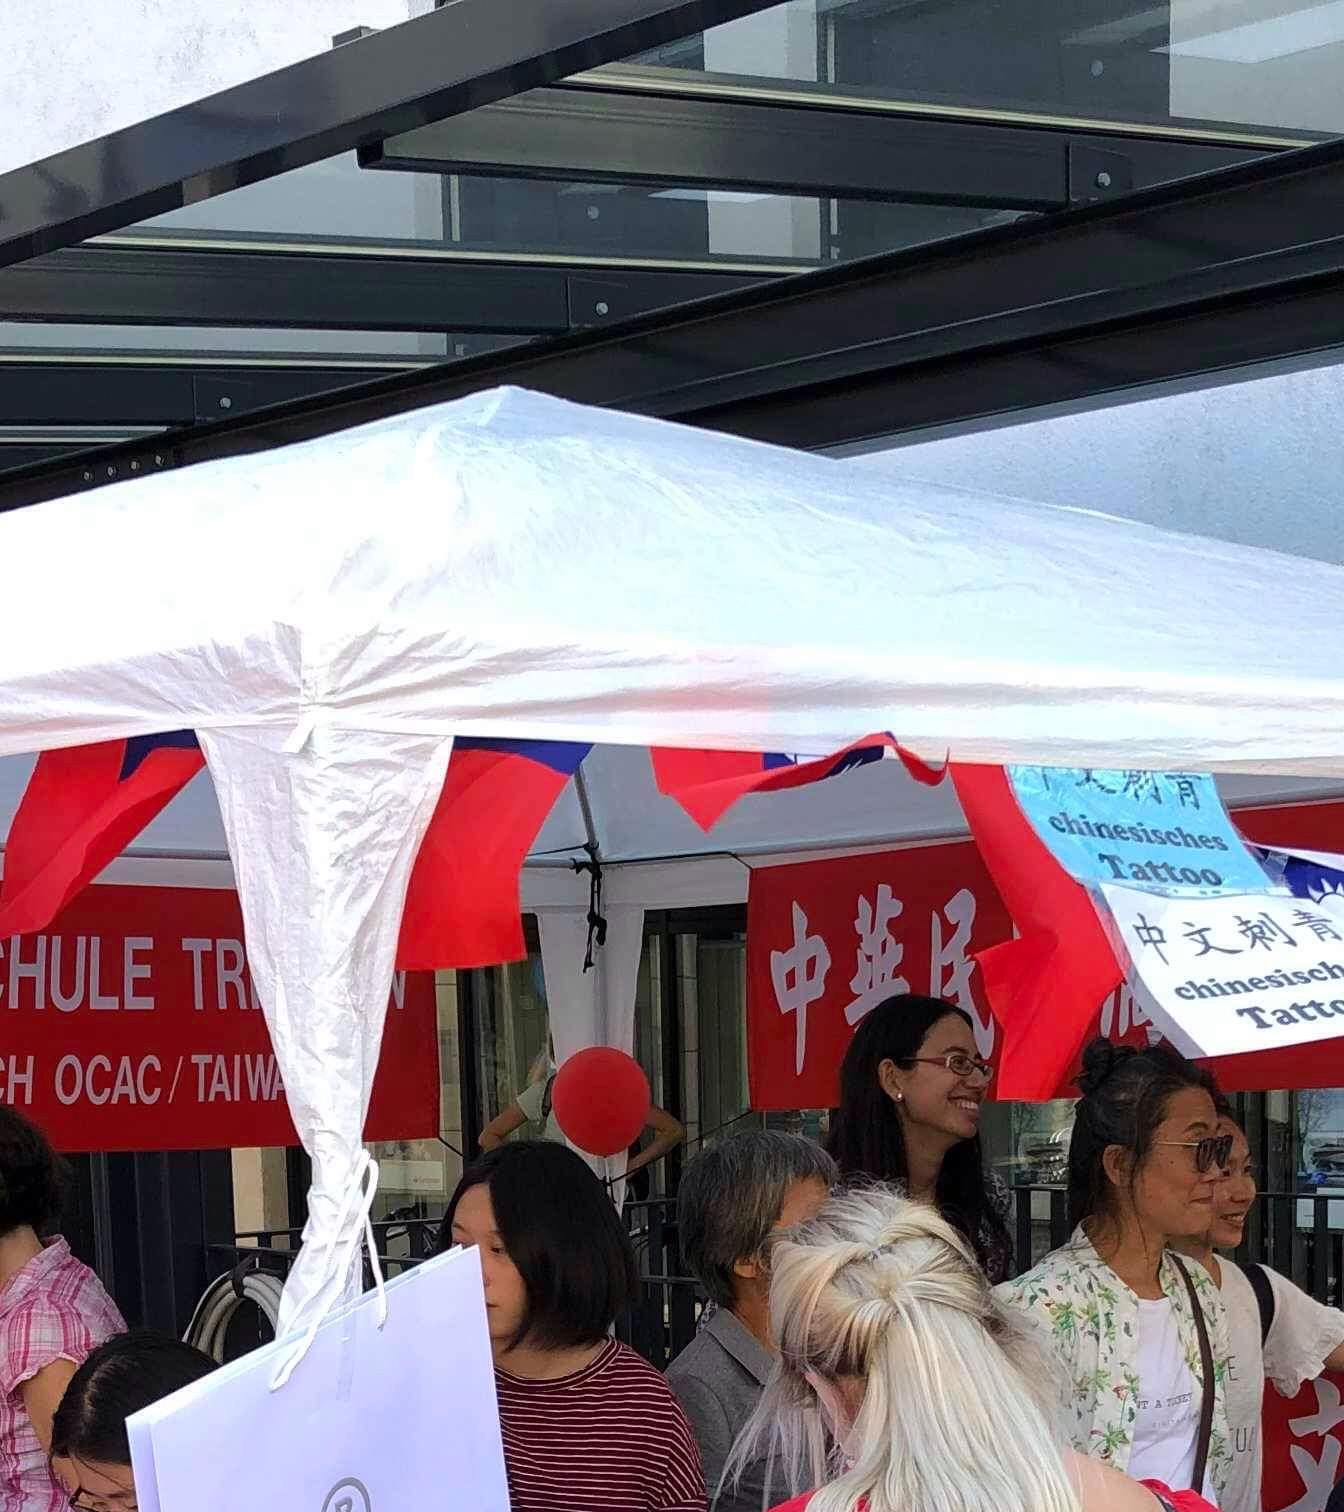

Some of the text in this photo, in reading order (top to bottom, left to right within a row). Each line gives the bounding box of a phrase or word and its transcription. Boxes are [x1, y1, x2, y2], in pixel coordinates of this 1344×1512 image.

[1049, 811, 1230, 852] chinesisches
[1097, 852, 1224, 887] Tattoo
[1132, 907, 1344, 967] 中文刺青
